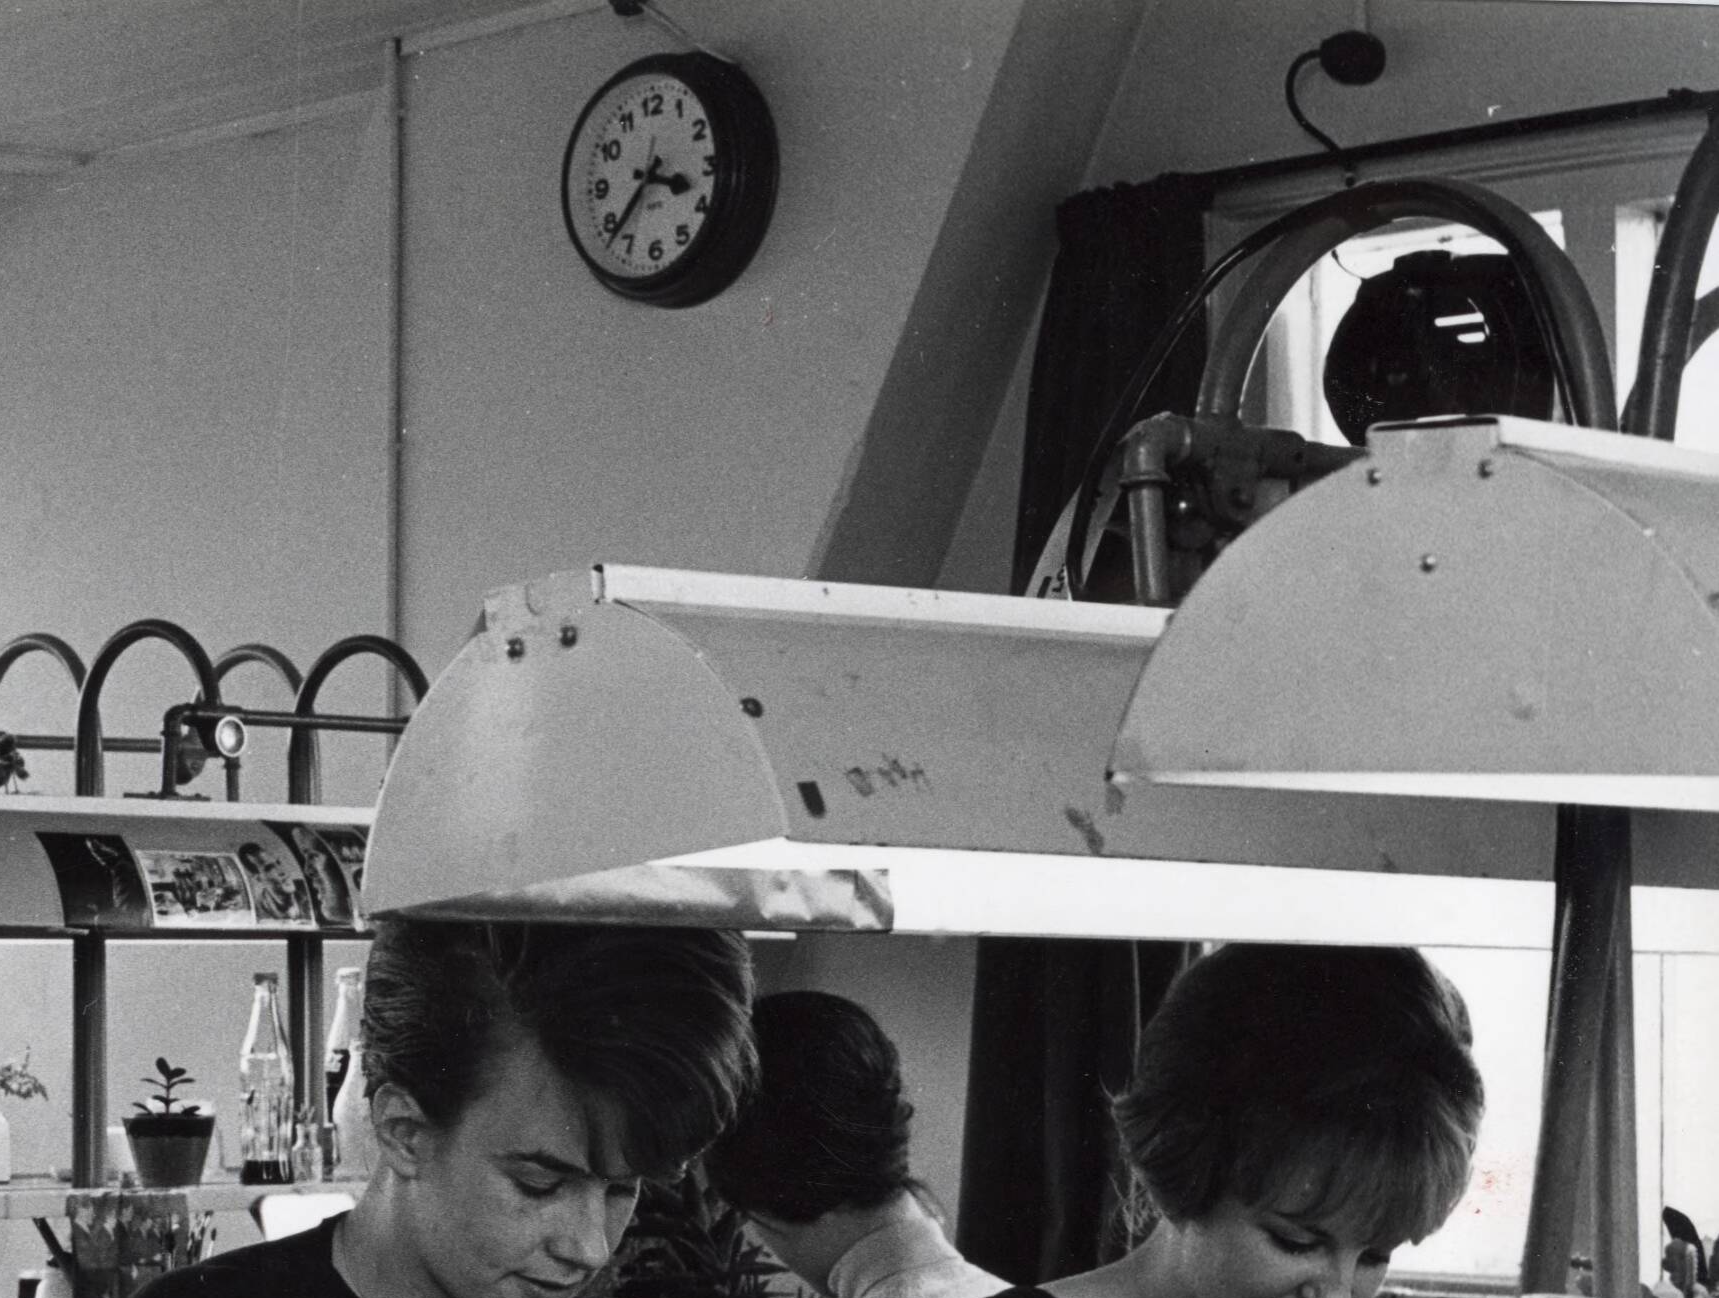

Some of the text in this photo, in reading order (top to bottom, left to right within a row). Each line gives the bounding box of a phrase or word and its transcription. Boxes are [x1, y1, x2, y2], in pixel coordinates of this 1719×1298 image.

[641, 94, 663, 118] 12
[675, 99, 684, 118] 1
[620, 112, 634, 133] 11
[692, 118, 706, 141] 2
[602, 139, 621, 162] 10
[703, 155, 716, 176] 3
[595, 178, 609, 200] 9
[695, 194, 708, 215] 4
[603, 212, 619, 233] 8
[622, 233, 635, 254] 7
[676, 224, 689, 246] 5
[648, 239, 663, 261] 6
